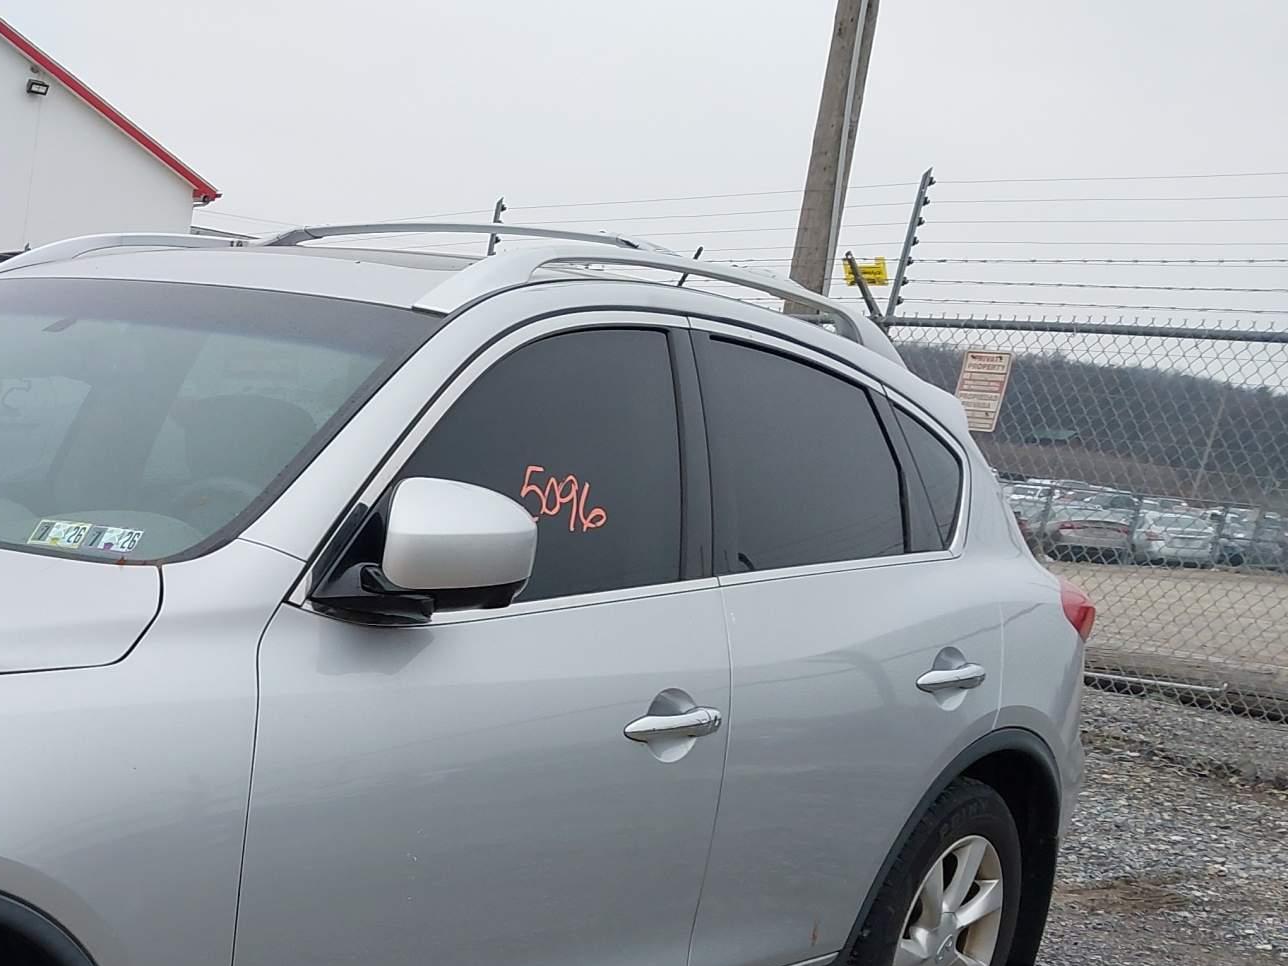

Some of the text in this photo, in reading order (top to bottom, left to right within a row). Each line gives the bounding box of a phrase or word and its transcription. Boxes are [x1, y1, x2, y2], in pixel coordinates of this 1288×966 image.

[520, 465, 607, 532] 5096
[66, 525, 87, 544] 26
[119, 531, 141, 550] 26
